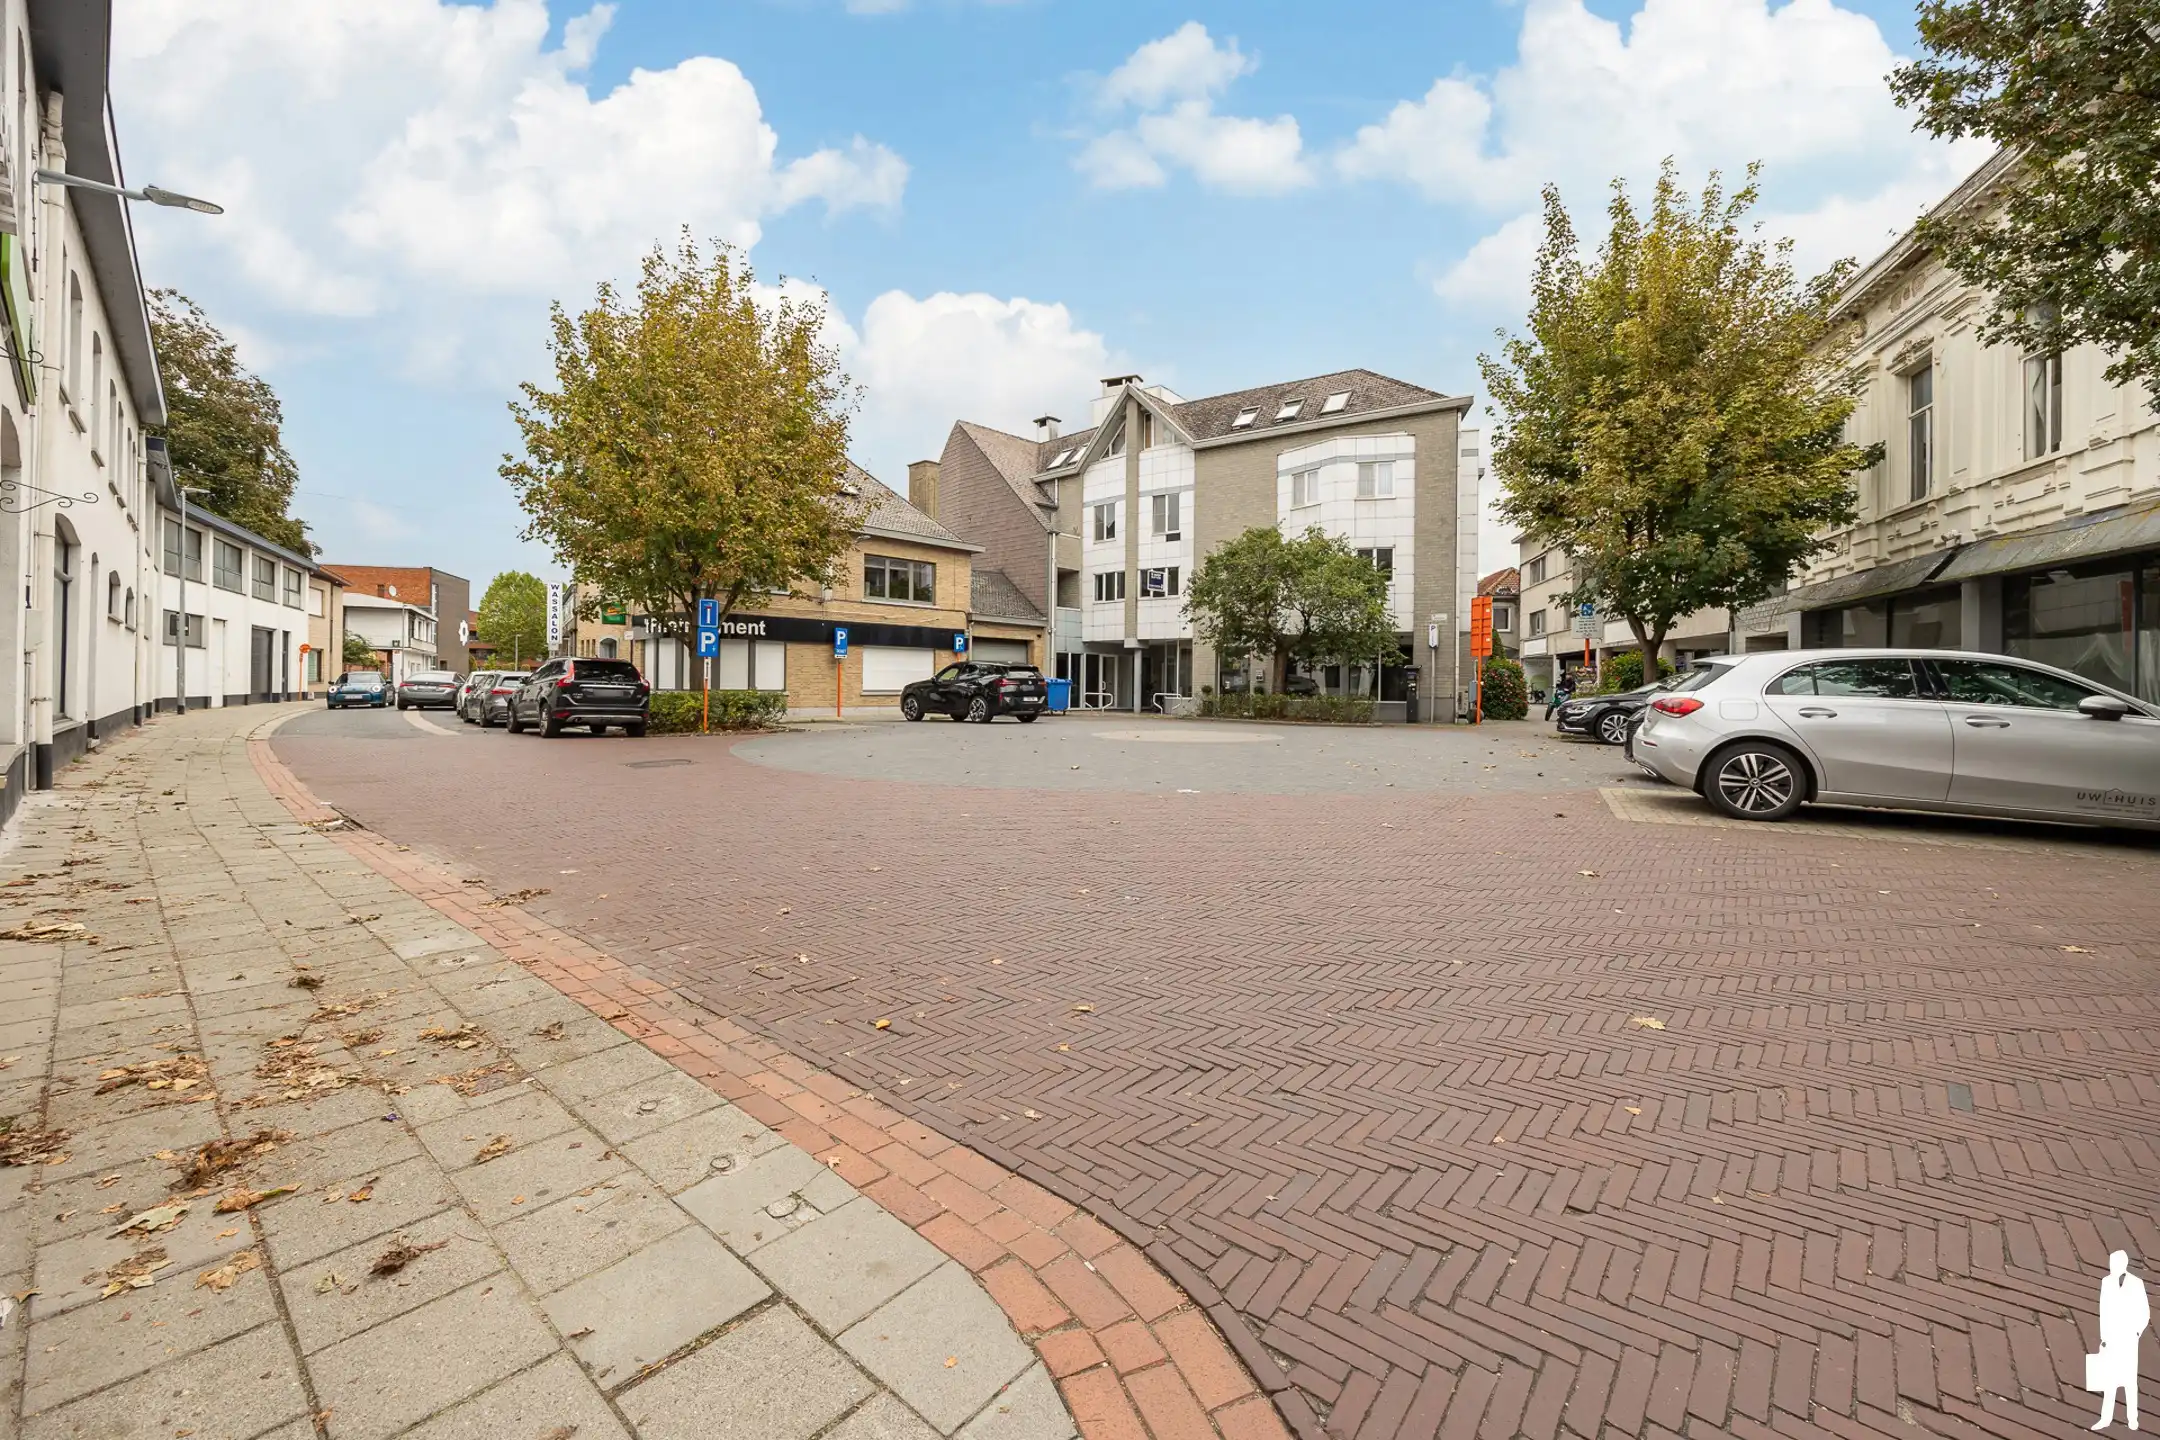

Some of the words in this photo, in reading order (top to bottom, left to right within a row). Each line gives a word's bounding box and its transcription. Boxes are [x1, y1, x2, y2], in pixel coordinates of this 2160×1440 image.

[551, 584, 559, 641] WASSALON
[701, 631, 716, 652] P
[836, 630, 846, 645] P
[956, 637, 964, 650] P
